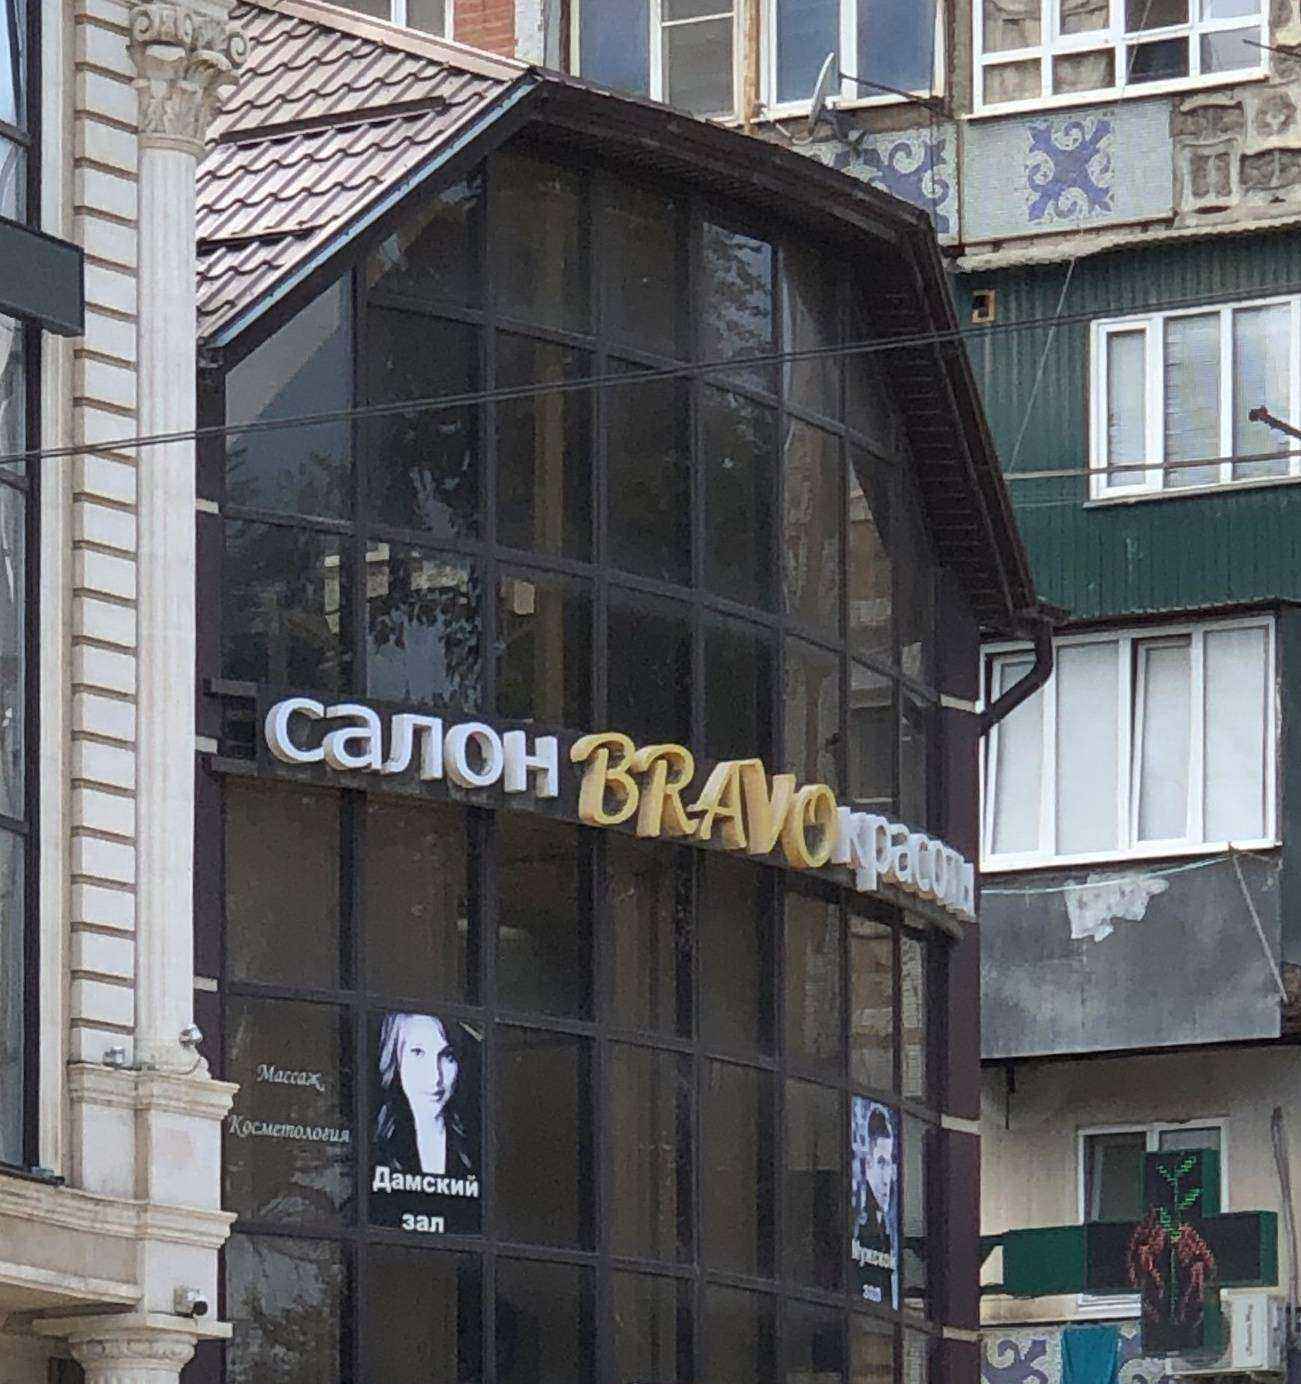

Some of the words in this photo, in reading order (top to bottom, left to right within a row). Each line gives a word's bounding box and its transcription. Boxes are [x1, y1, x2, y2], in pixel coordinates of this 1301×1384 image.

[265, 696, 558, 798] салон
[569, 731, 838, 870] BRAVO
[256, 1064, 325, 1092] Массаж
[228, 1114, 350, 1143] Косметология
[373, 1165, 480, 1199] Дамский
[402, 1213, 445, 1234] зал
